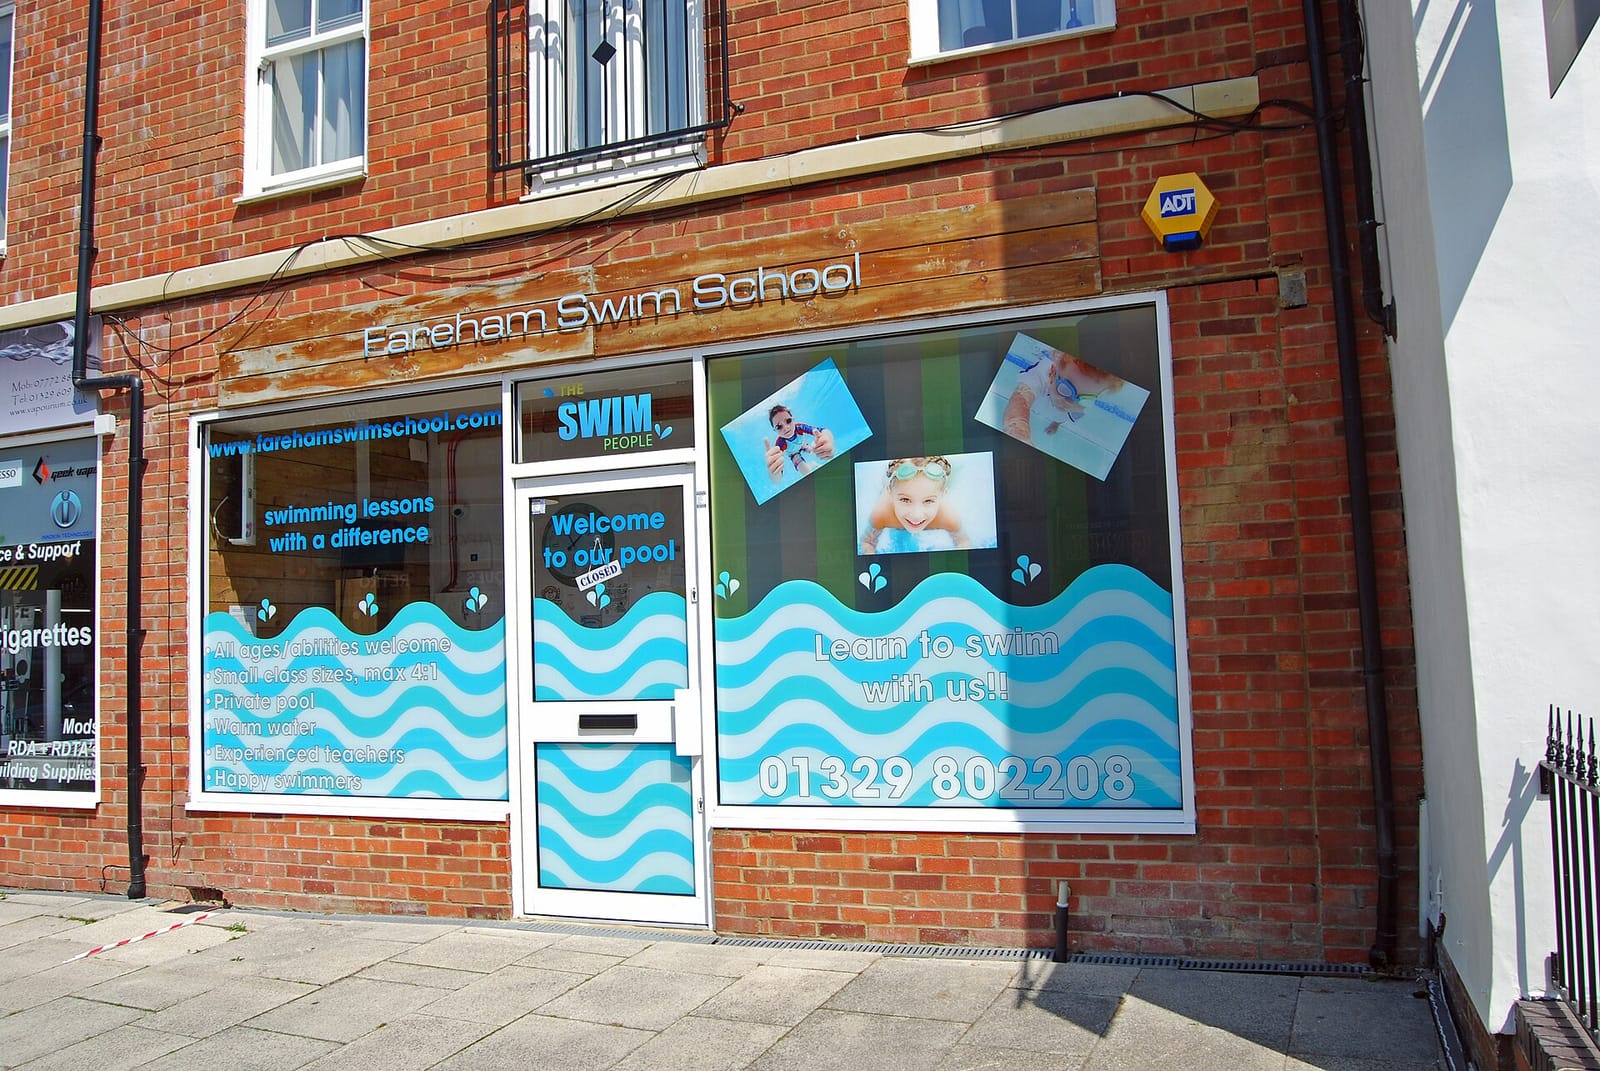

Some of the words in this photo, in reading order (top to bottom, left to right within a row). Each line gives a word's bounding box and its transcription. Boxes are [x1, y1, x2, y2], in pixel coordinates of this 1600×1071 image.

[1161, 193, 1195, 214] ADT
[363, 307, 547, 359] Fareham
[557, 286, 681, 329] Swim
[692, 252, 863, 309] School
[559, 383, 584, 397] THE
[557, 393, 653, 441] SWIM
[208, 408, 503, 459] www.farehamswimschool.com
[603, 434, 653, 450] PEOPLE
[0, 469, 16, 479] SSO
[50, 466, 74, 482] geek
[264, 501, 358, 526] swimming
[363, 495, 435, 518] lessons
[551, 511, 665, 536] Welcome
[15, 544, 25, 560] &
[28, 540, 81, 561] Support
[270, 532, 307, 553] with
[312, 533, 326, 549] a
[330, 525, 430, 549] difference
[543, 546, 567, 568] to
[573, 547, 613, 567] our
[620, 539, 676, 569] pool
[579, 563, 618, 588] CLOSED
[0, 622, 92, 654] igarettes
[214, 641, 234, 658] All
[240, 637, 359, 662] ages/abilities
[366, 636, 452, 656] welcome
[814, 633, 908, 662] Learn
[919, 630, 953, 658] to
[966, 626, 1060, 657] swim
[213, 665, 259, 685] Small
[263, 663, 307, 684] class
[312, 664, 359, 685] sizes,
[364, 664, 406, 682] max
[411, 662, 438, 682] 4:1
[861, 672, 934, 703] with
[946, 671, 1009, 702] us!!
[214, 693, 271, 710] Private
[276, 693, 315, 713] pool
[62, 718, 97, 735] Mods
[214, 718, 262, 736] Warm
[267, 719, 317, 736] water
[8, 741, 37, 756] RDA
[214, 744, 320, 765] Experienced
[324, 745, 405, 764] teachers
[42, 763, 97, 783] Supplies
[215, 770, 269, 791] Happy
[274, 771, 362, 790] swimmers
[758, 755, 914, 799] 01329
[931, 755, 1135, 800] 802208
